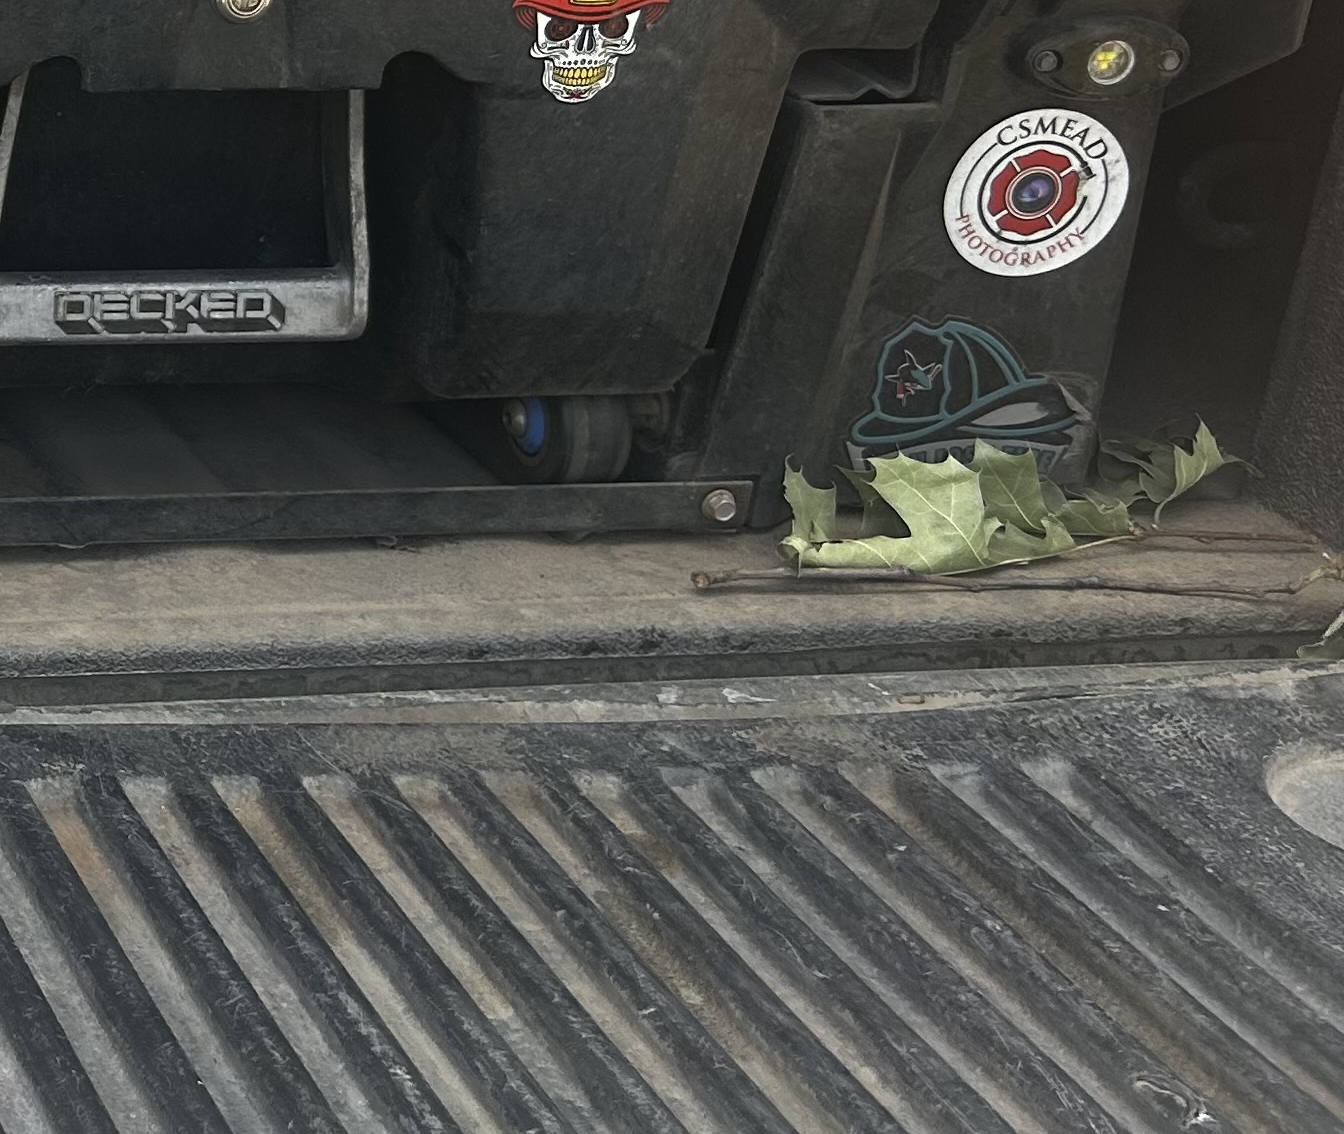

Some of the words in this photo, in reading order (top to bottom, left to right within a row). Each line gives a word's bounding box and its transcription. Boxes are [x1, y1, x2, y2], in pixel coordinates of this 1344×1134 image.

[995, 116, 1109, 161] CSMEAD
[954, 213, 1085, 267] PHOTOGRAPHY
[53, 288, 285, 334] DECKED
